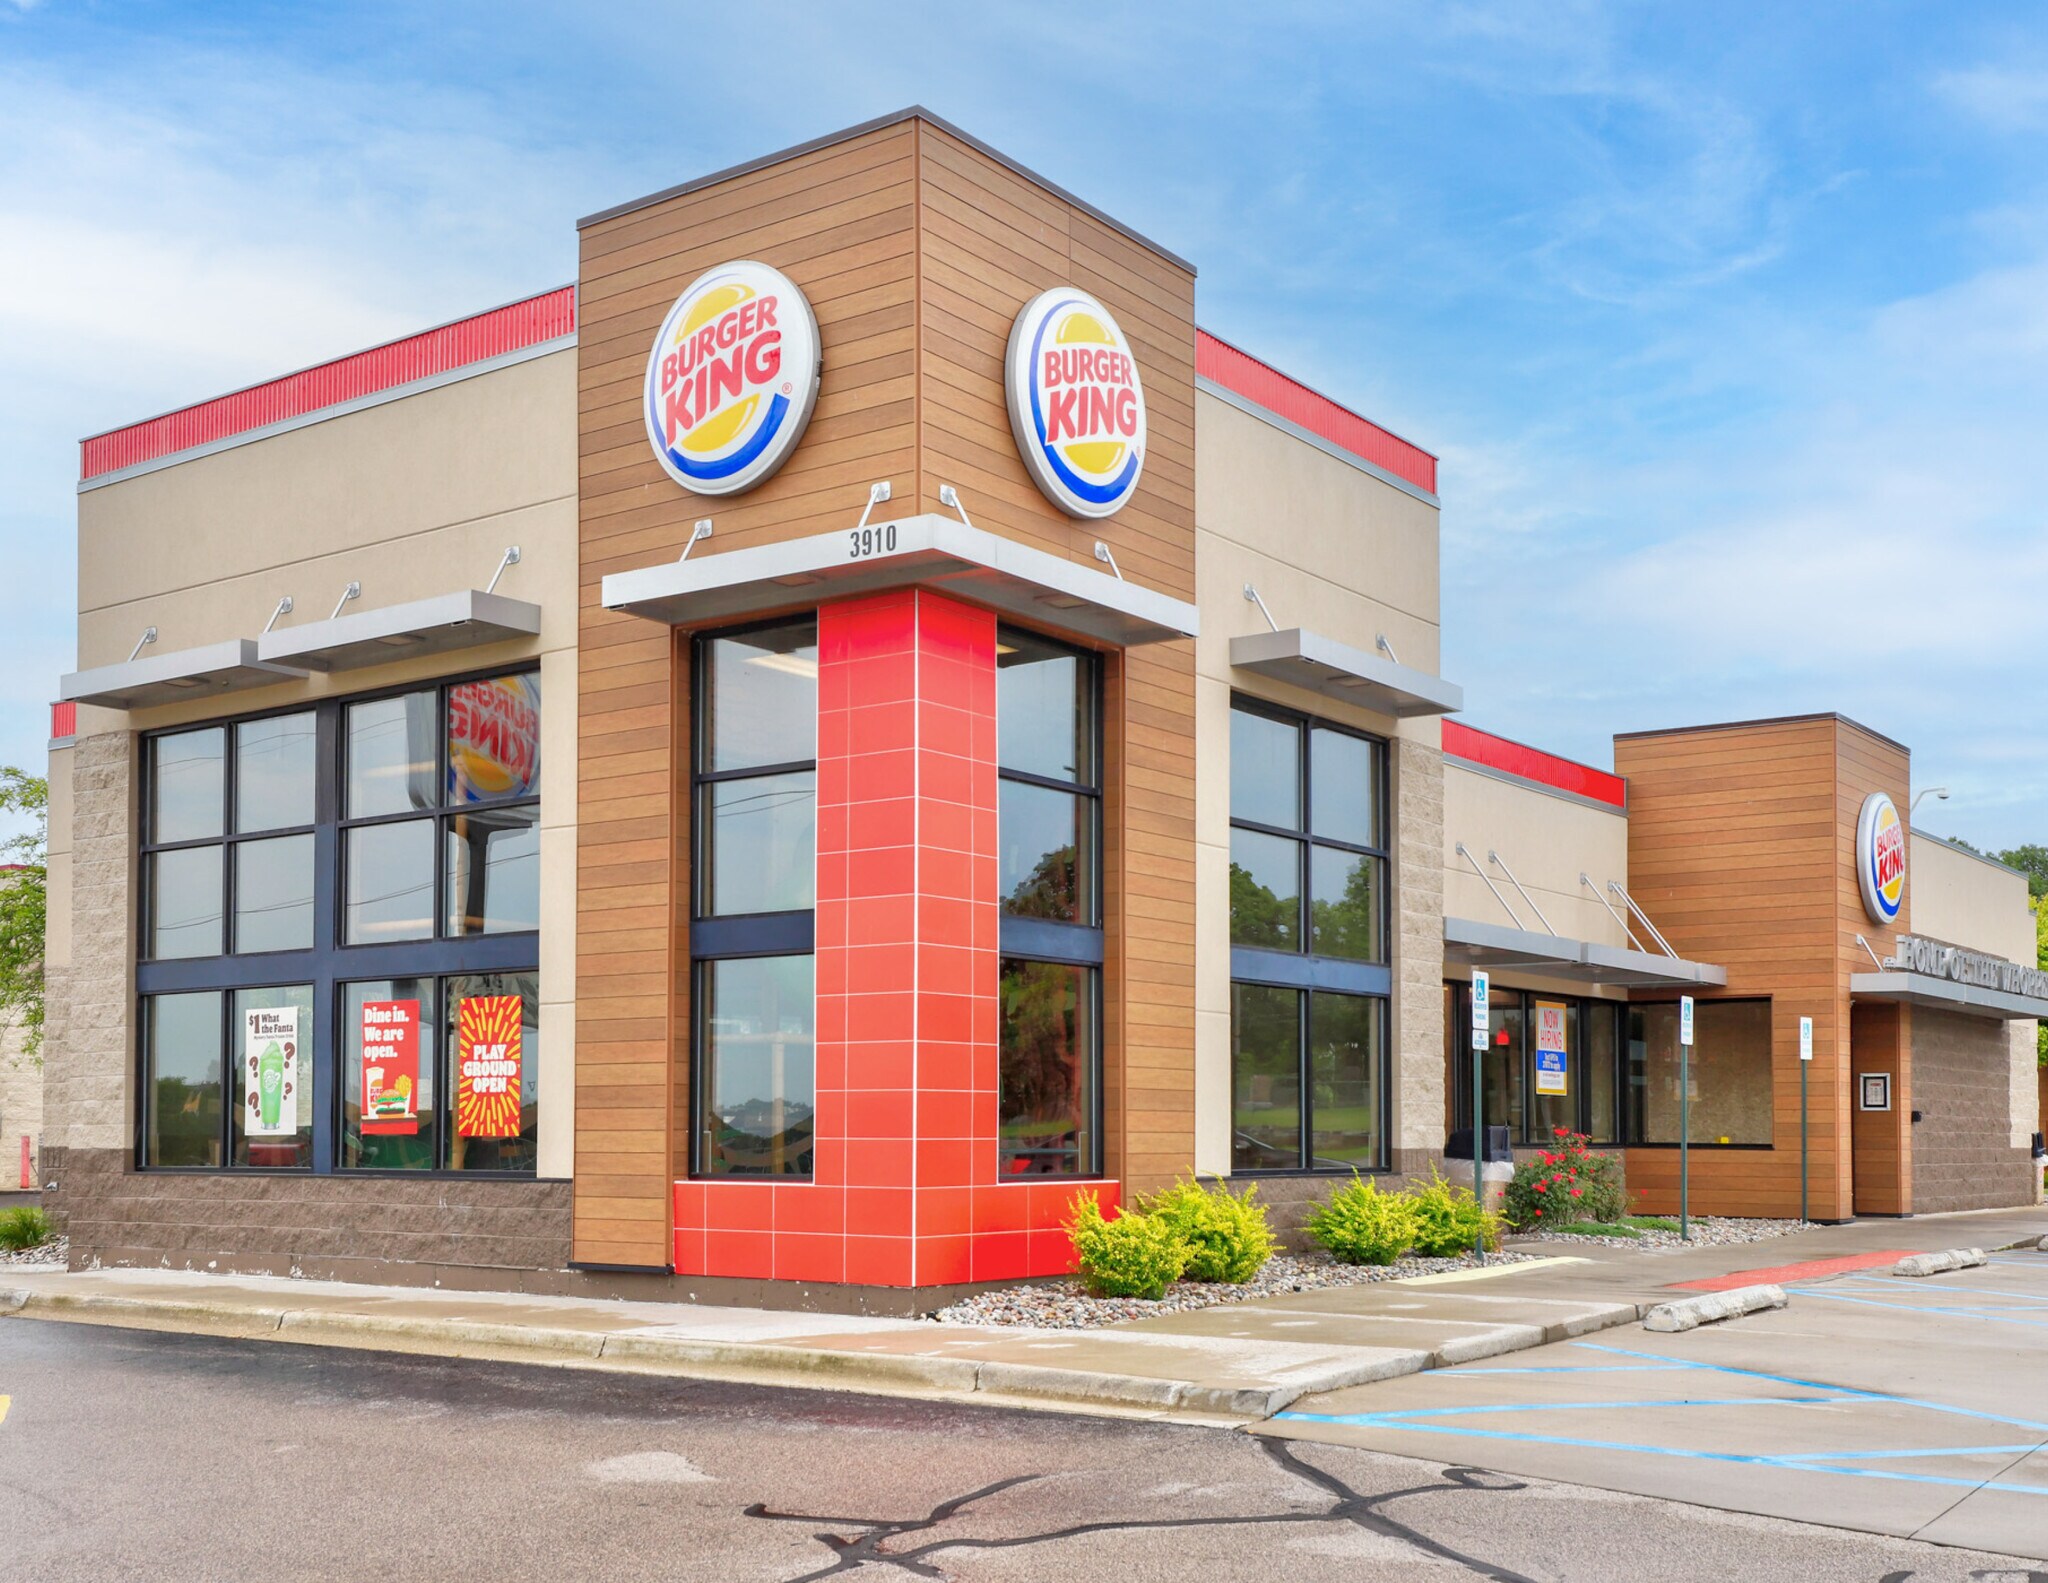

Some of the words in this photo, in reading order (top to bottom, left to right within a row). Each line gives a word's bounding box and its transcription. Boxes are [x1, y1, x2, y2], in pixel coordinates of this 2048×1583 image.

[661, 295, 778, 397] BURGER
[1044, 348, 1133, 389] BURGER
[665, 329, 782, 448] KING
[1046, 386, 1137, 443] KING
[849, 524, 897, 558] 3910
[1877, 823, 1902, 858] BURGE
[1896, 935, 1948, 978] HOME
[1998, 961, 2048, 999] WHOPPE
[249, 1014, 260, 1034] $1
[261, 1013, 280, 1023] What
[364, 1006, 391, 1024] Dine
[392, 1005, 410, 1023] in.
[1543, 1009, 1559, 1029] NOW
[261, 1024, 273, 1034] the
[274, 1024, 294, 1033] Fanta
[364, 1027, 383, 1042] We
[383, 1028, 404, 1041] are
[1540, 1029, 1562, 1050] HIRING
[364, 1045, 398, 1062] open.
[473, 1044, 507, 1061] PLAY
[463, 1060, 517, 1077] GROUND
[472, 1077, 507, 1093] OPEN
